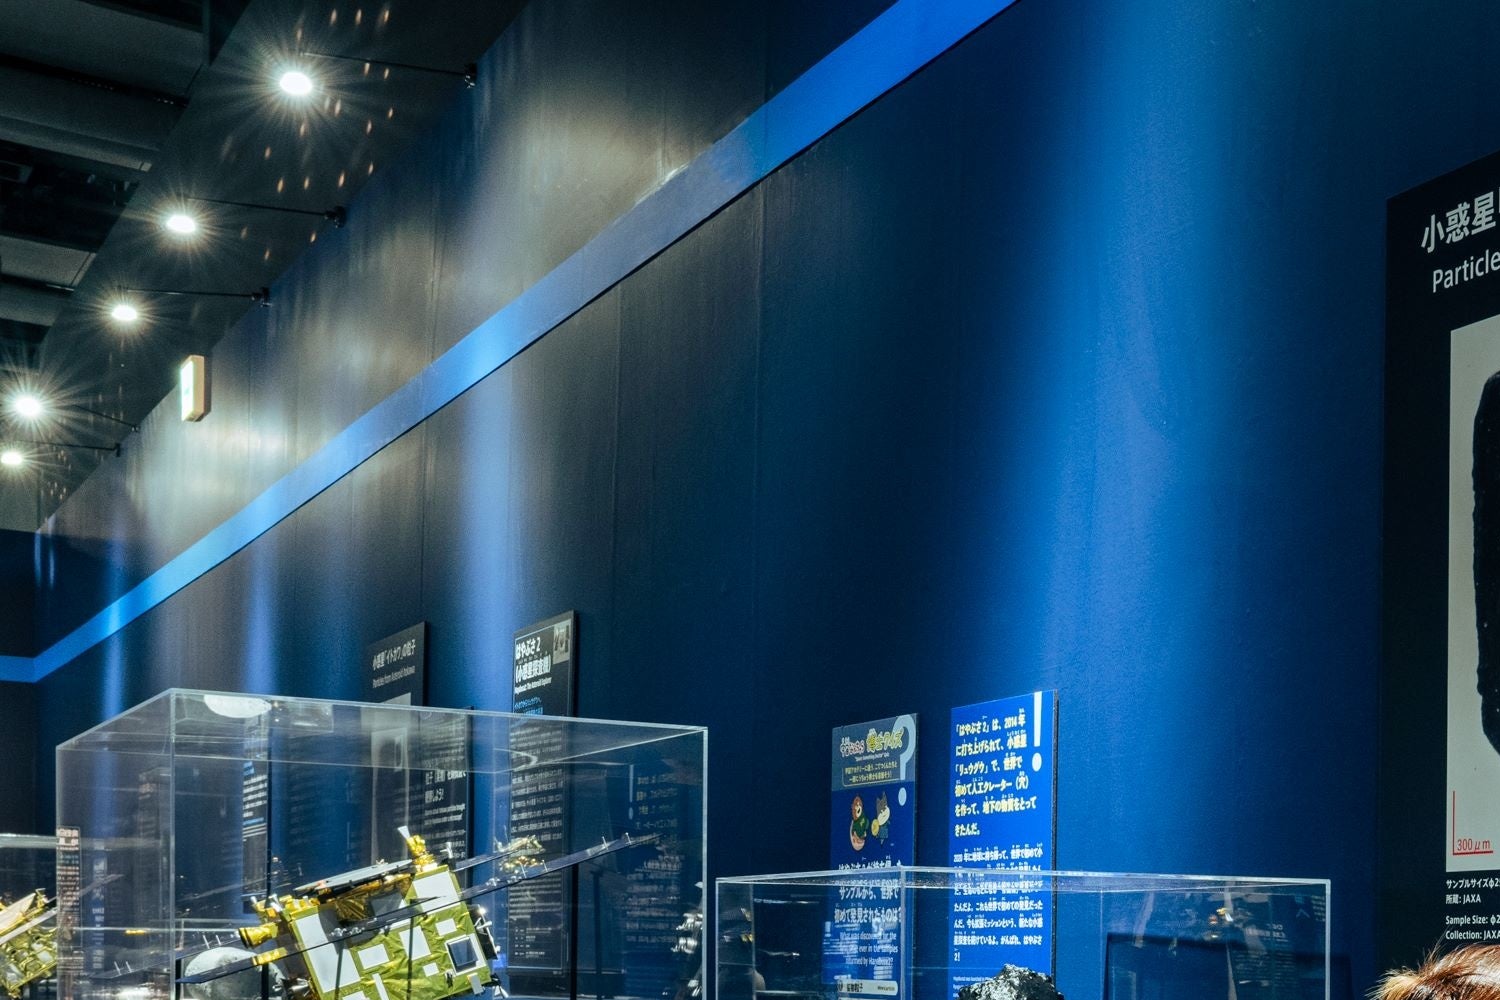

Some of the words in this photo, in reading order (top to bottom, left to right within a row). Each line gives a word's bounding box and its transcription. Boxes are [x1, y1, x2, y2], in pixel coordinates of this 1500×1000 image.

[955, 823, 980, 837] きたんだ。
[1445, 915, 1470, 926] Sample
[1471, 914, 1488, 924] Size:
[1445, 930, 1482, 940] Collection:
